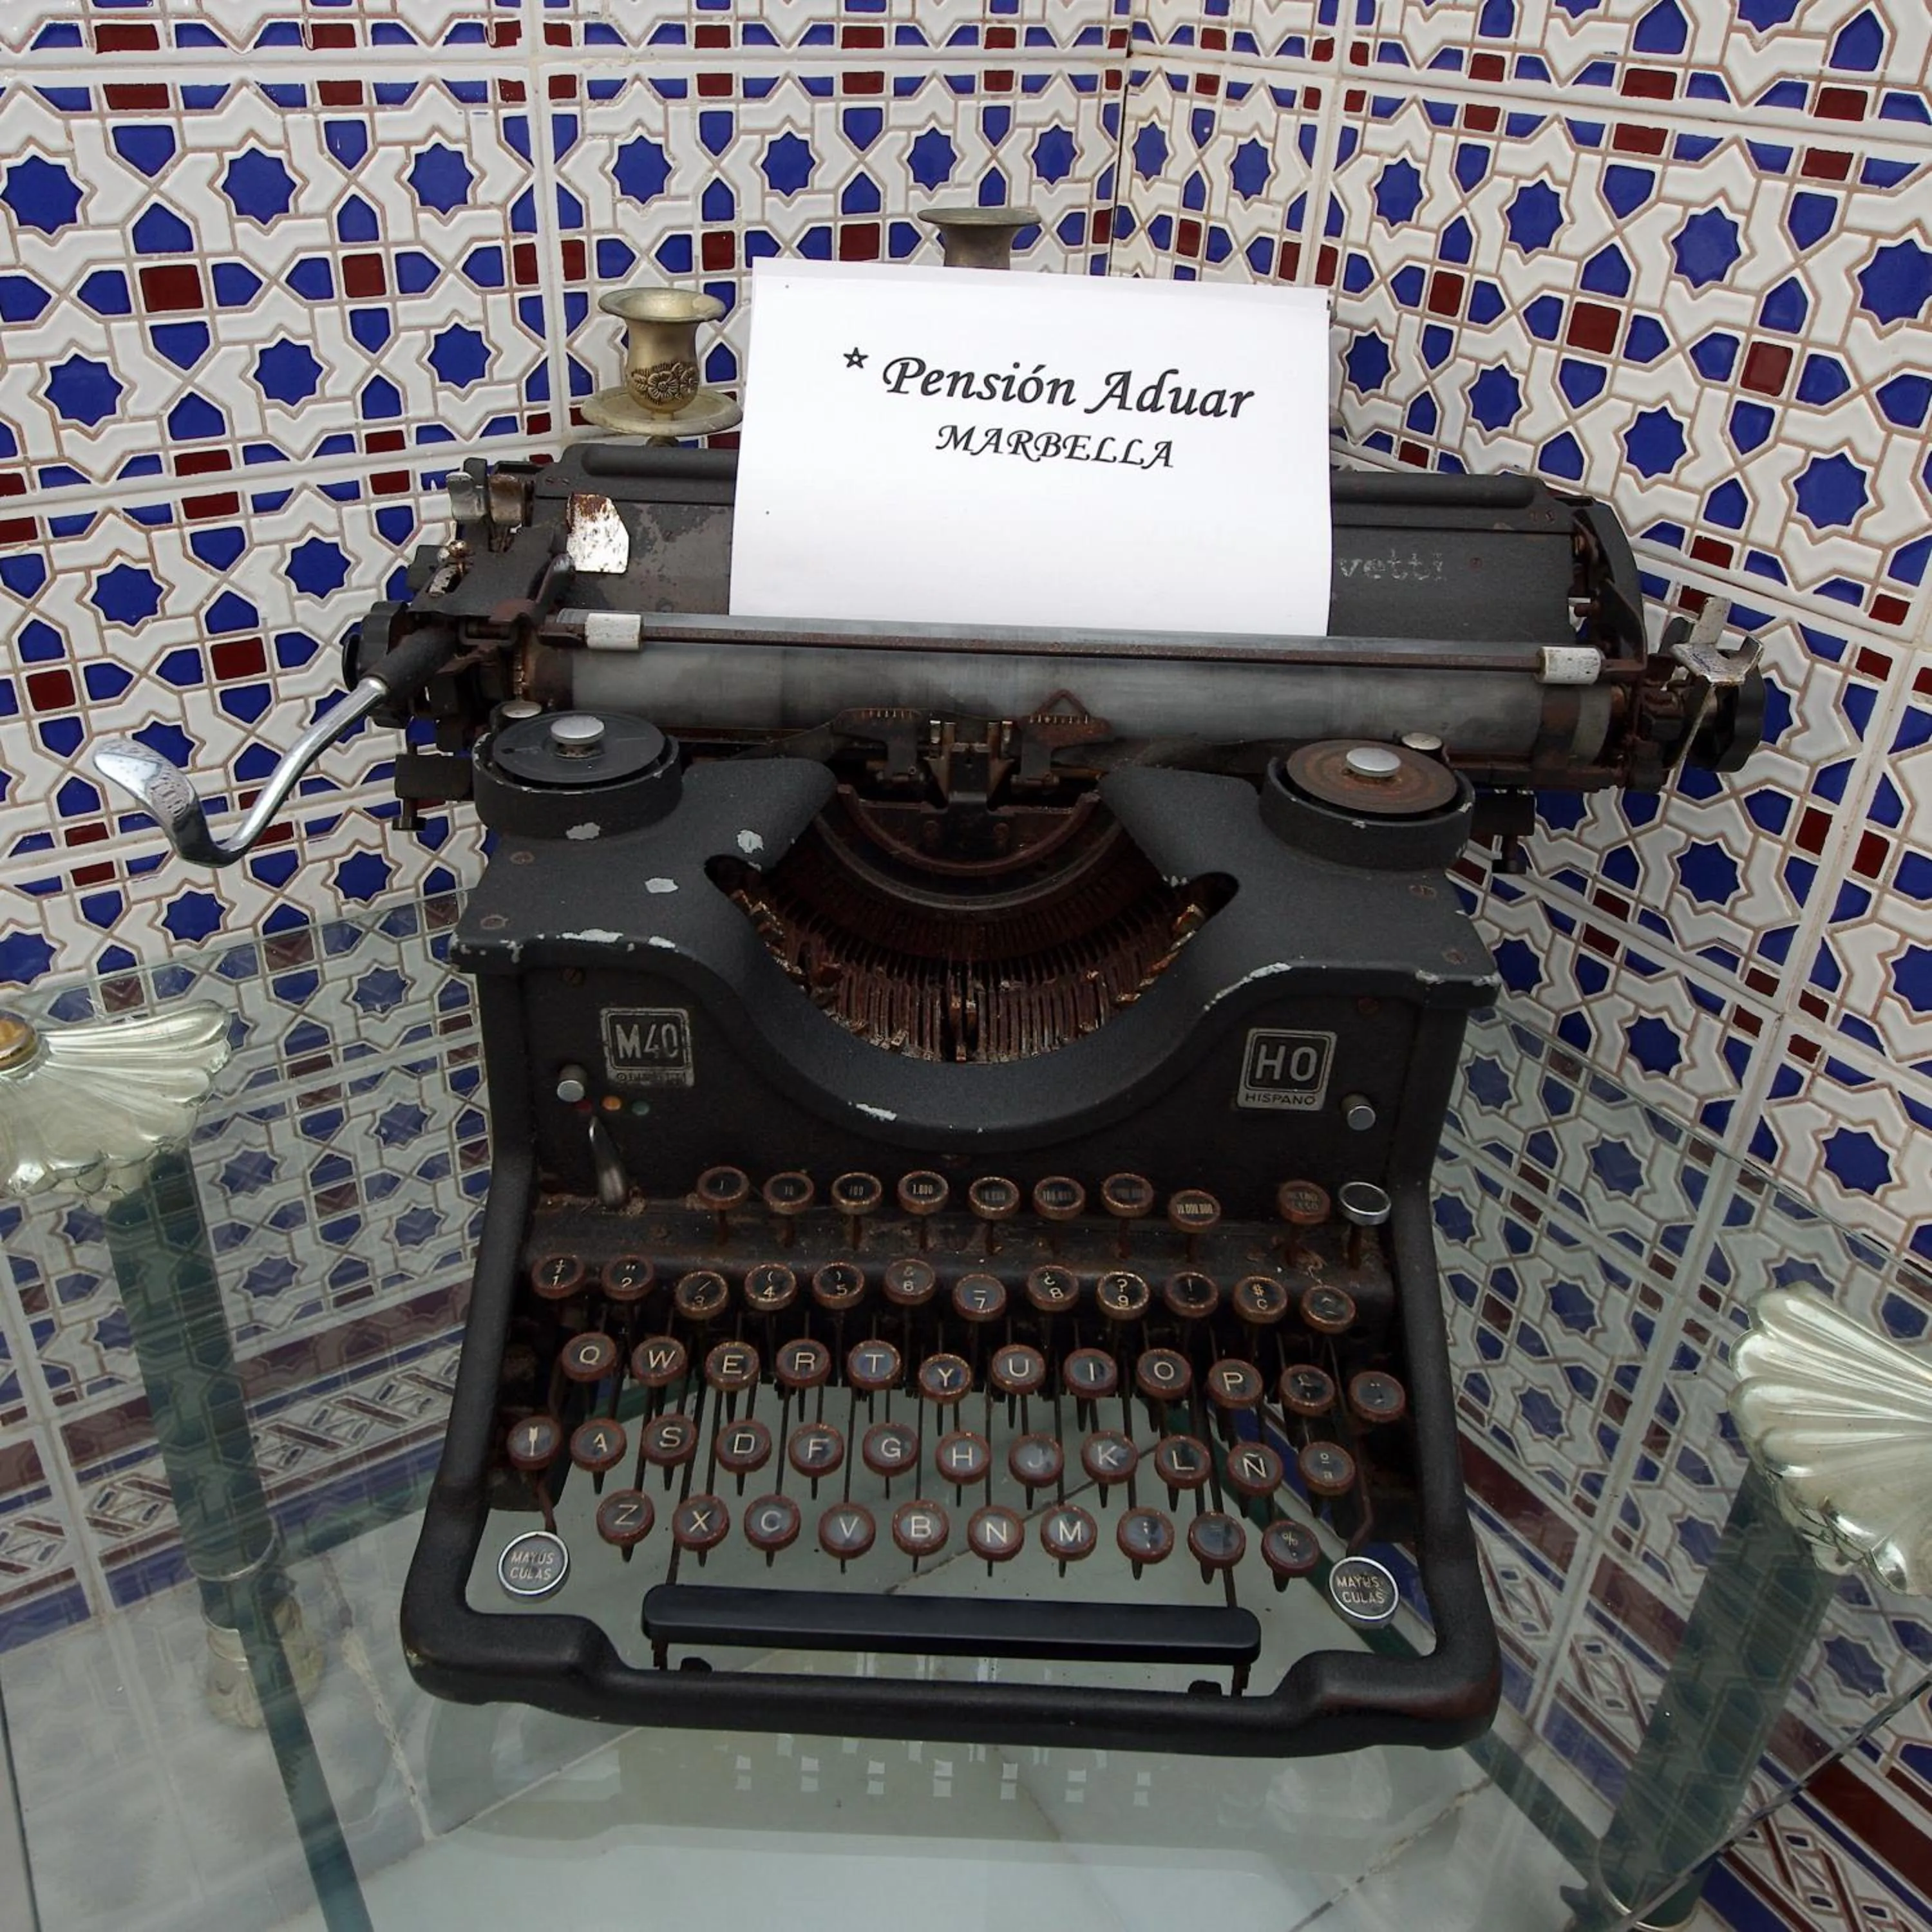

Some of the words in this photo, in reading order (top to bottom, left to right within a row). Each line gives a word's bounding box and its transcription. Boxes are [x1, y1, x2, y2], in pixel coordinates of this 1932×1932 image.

[883, 356, 1076, 406] Pensión
[1084, 369, 1255, 418] Aduar
[936, 425, 1173, 469] MARBELLA
[615, 1023, 679, 1059] M40
[1255, 1044, 1318, 1082] HO
[1244, 1092, 1316, 1106] HISPANO
[580, 1345, 600, 1365] Q
[648, 1349, 676, 1369] W
[722, 1354, 744, 1374] E
[795, 1352, 816, 1371] R
[865, 1354, 886, 1374] T
[937, 1368, 954, 1387] Y
[1009, 1358, 1029, 1377] U
[1153, 1361, 1175, 1380] O
[1222, 1372, 1244, 1391] P
[593, 1432, 608, 1453] A
[659, 1426, 682, 1448] S
[733, 1433, 755, 1454] D
[808, 1437, 829, 1460] F
[880, 1437, 901, 1459] G
[952, 1445, 973, 1468] H
[1097, 1444, 1119, 1467] K
[1172, 1450, 1195, 1471] L
[614, 1504, 639, 1526] Z
[689, 1510, 712, 1533] X
[760, 1510, 782, 1532] C
[839, 1516, 860, 1539] V
[910, 1515, 932, 1538] B
[985, 1520, 1007, 1544] N
[1058, 1519, 1083, 1543] M
[509, 1566, 553, 1580] CULAS
